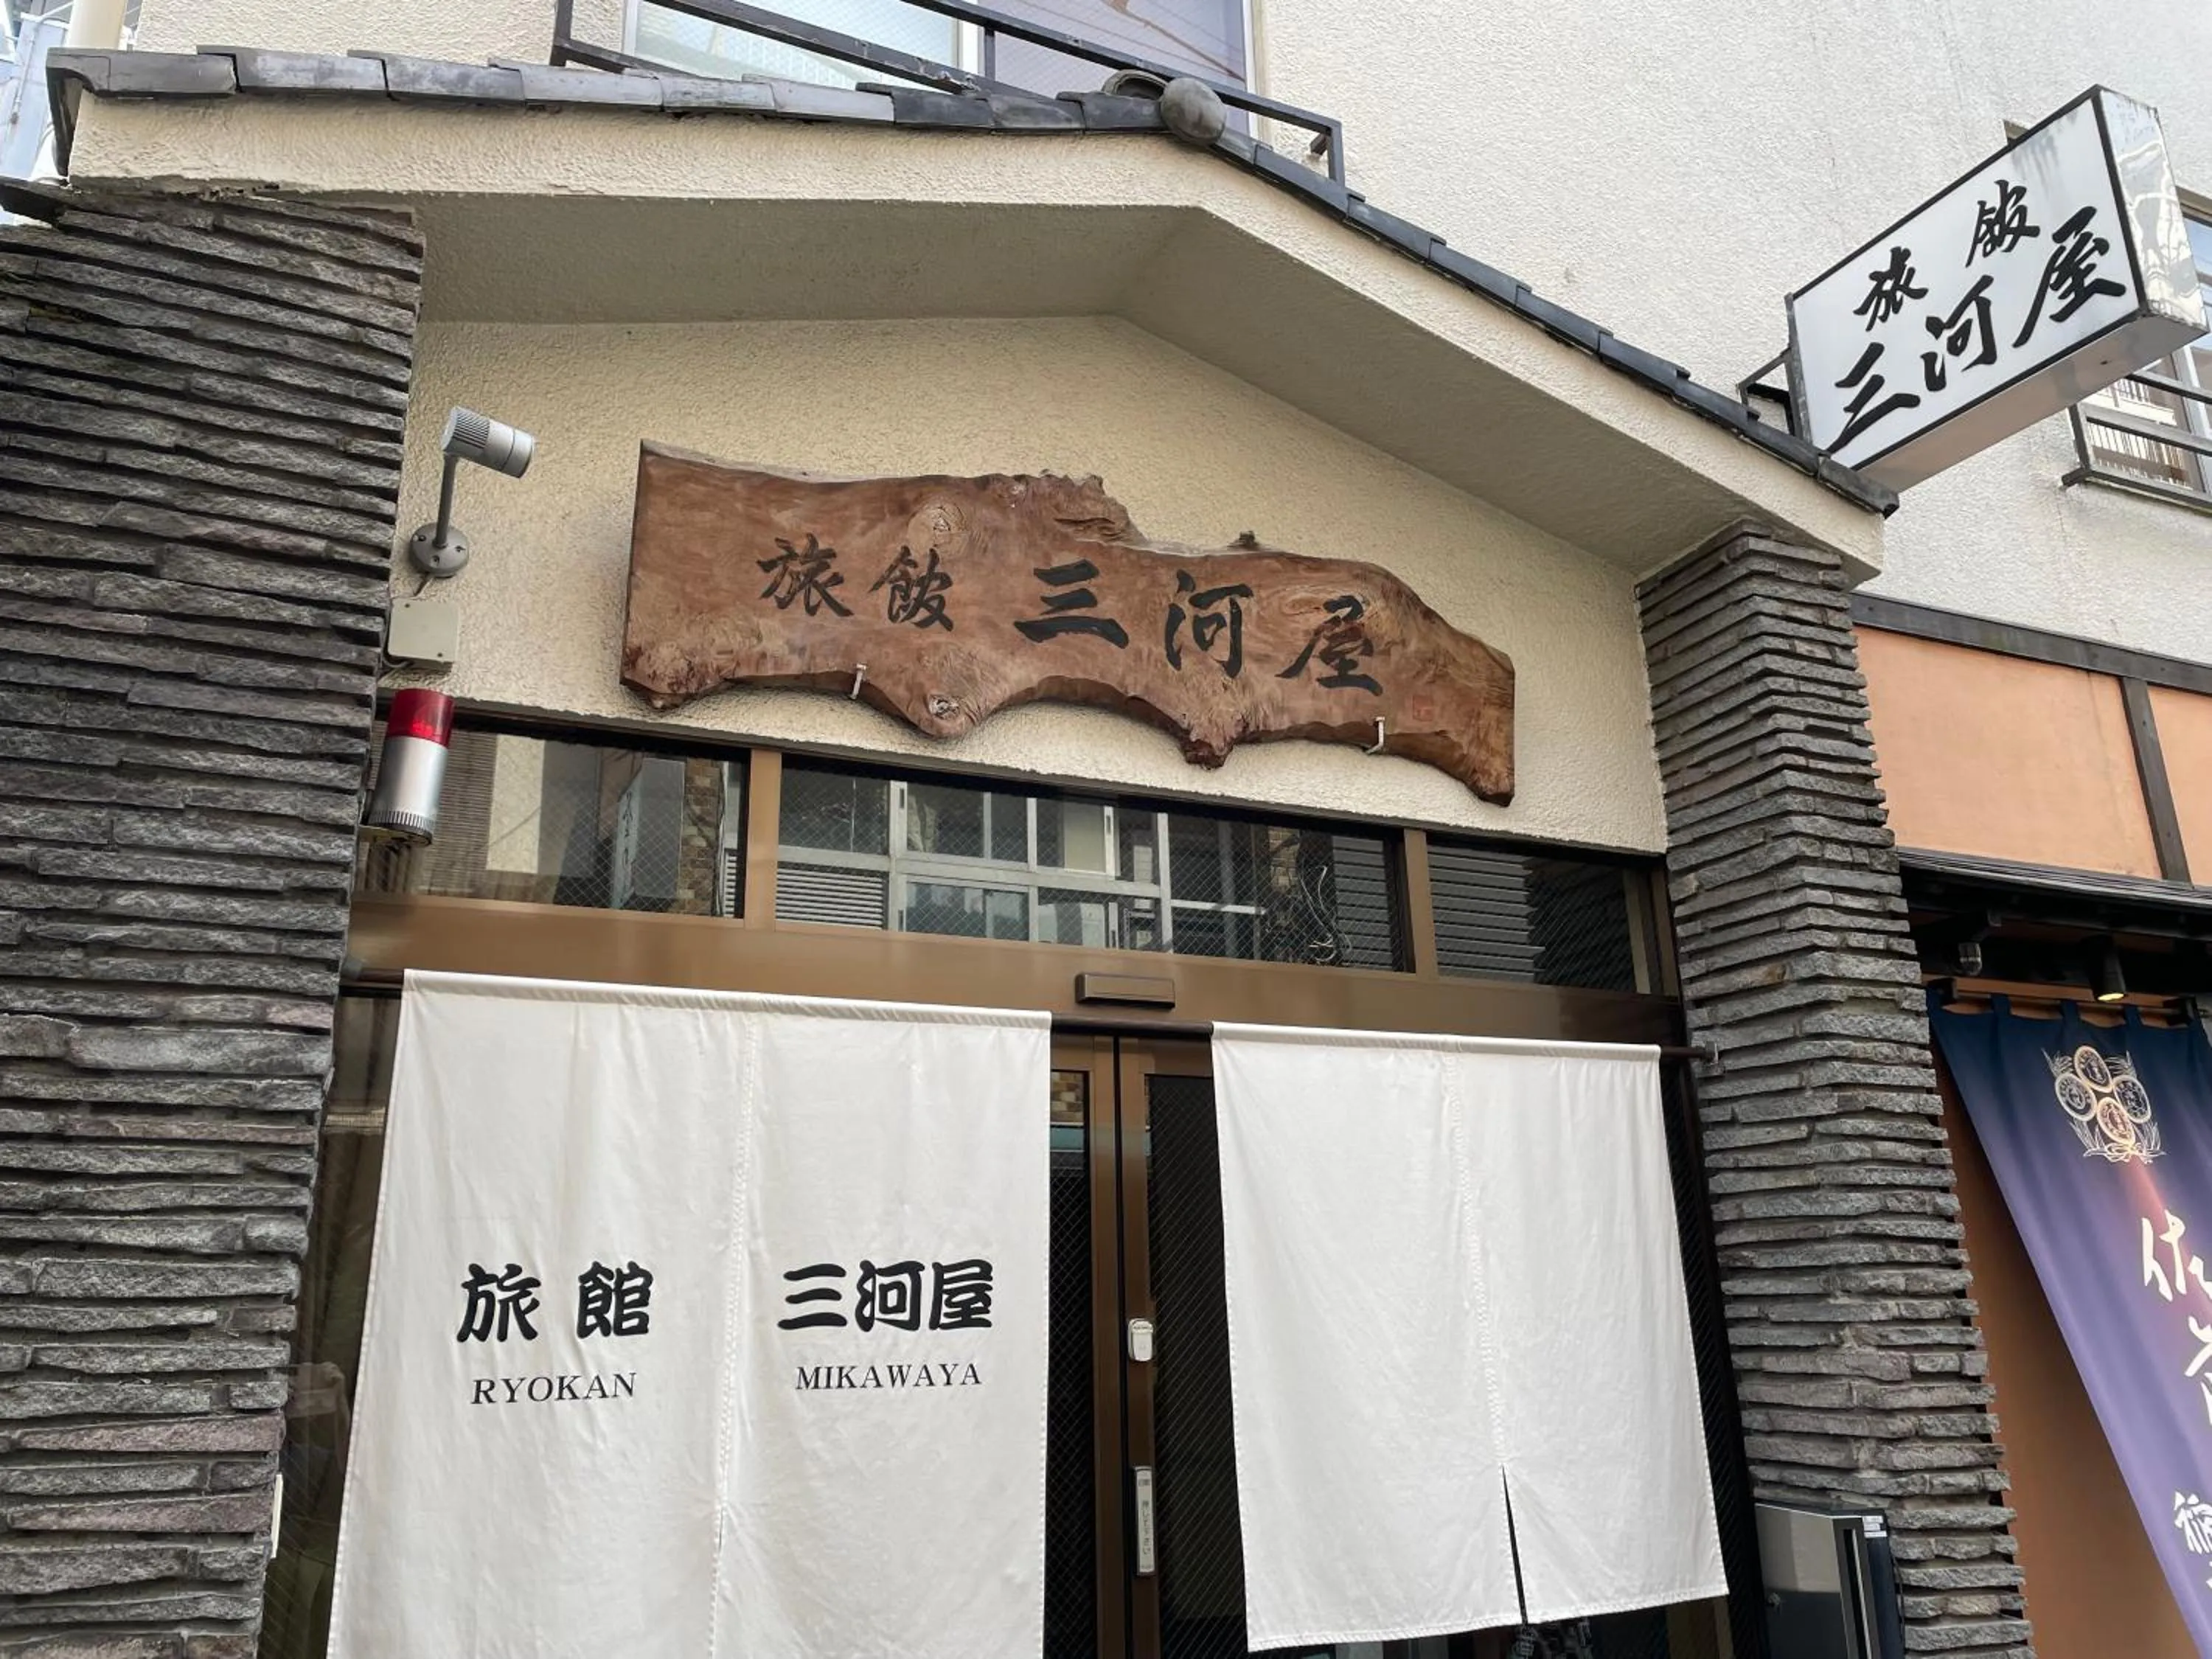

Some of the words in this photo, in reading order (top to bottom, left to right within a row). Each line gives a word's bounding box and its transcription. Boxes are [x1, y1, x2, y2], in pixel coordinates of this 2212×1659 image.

[1825, 206, 2126, 454] 三河屋
[1013, 558, 1384, 697] 三河屋
[456, 1261, 654, 1343] 旅館
[777, 1258, 993, 1333] 三河屋
[470, 1371, 637, 1405] RYOKAN
[794, 1362, 983, 1392] MIKAWAYA
